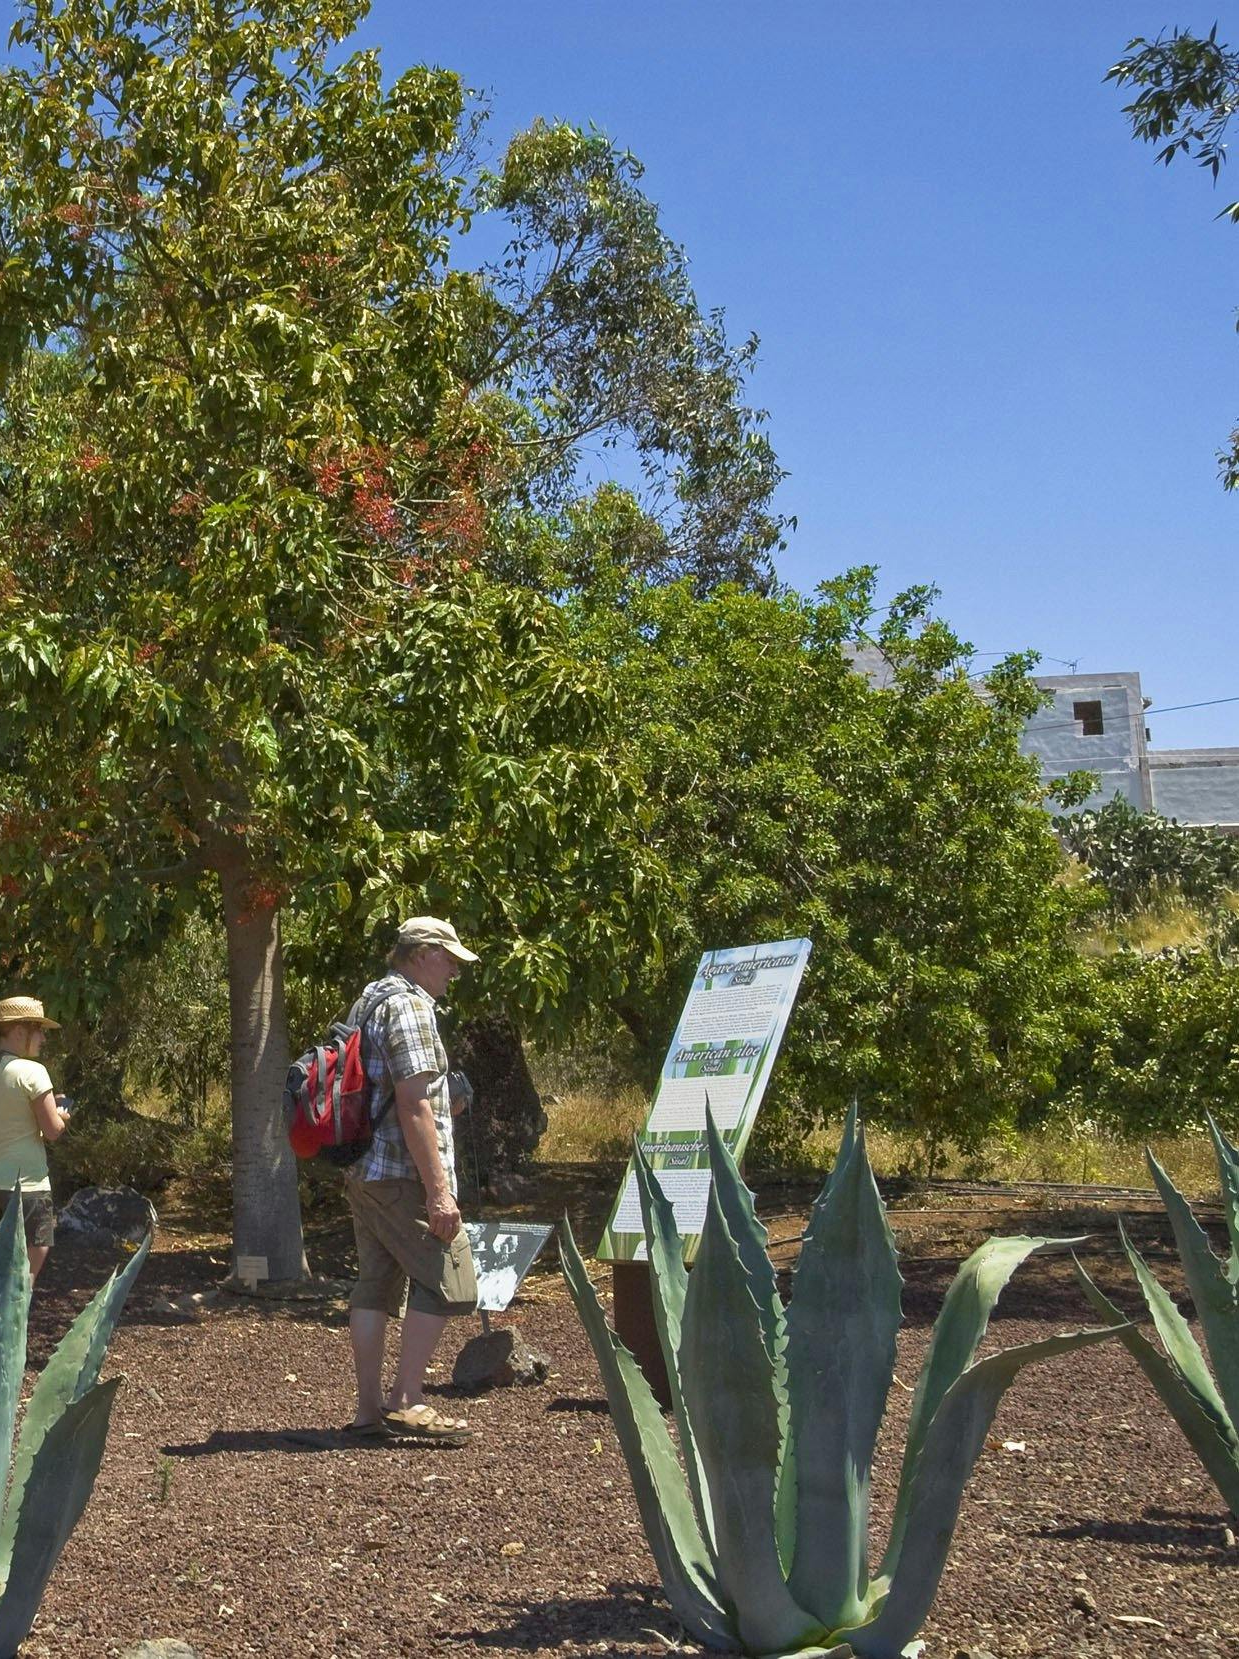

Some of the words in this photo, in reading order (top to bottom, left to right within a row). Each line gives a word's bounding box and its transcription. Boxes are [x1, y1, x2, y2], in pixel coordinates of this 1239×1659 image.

[701, 963, 733, 980] Agave
[734, 956, 797, 972] americana
[674, 1049, 730, 1063] American
[732, 1043, 759, 1057] aloe
